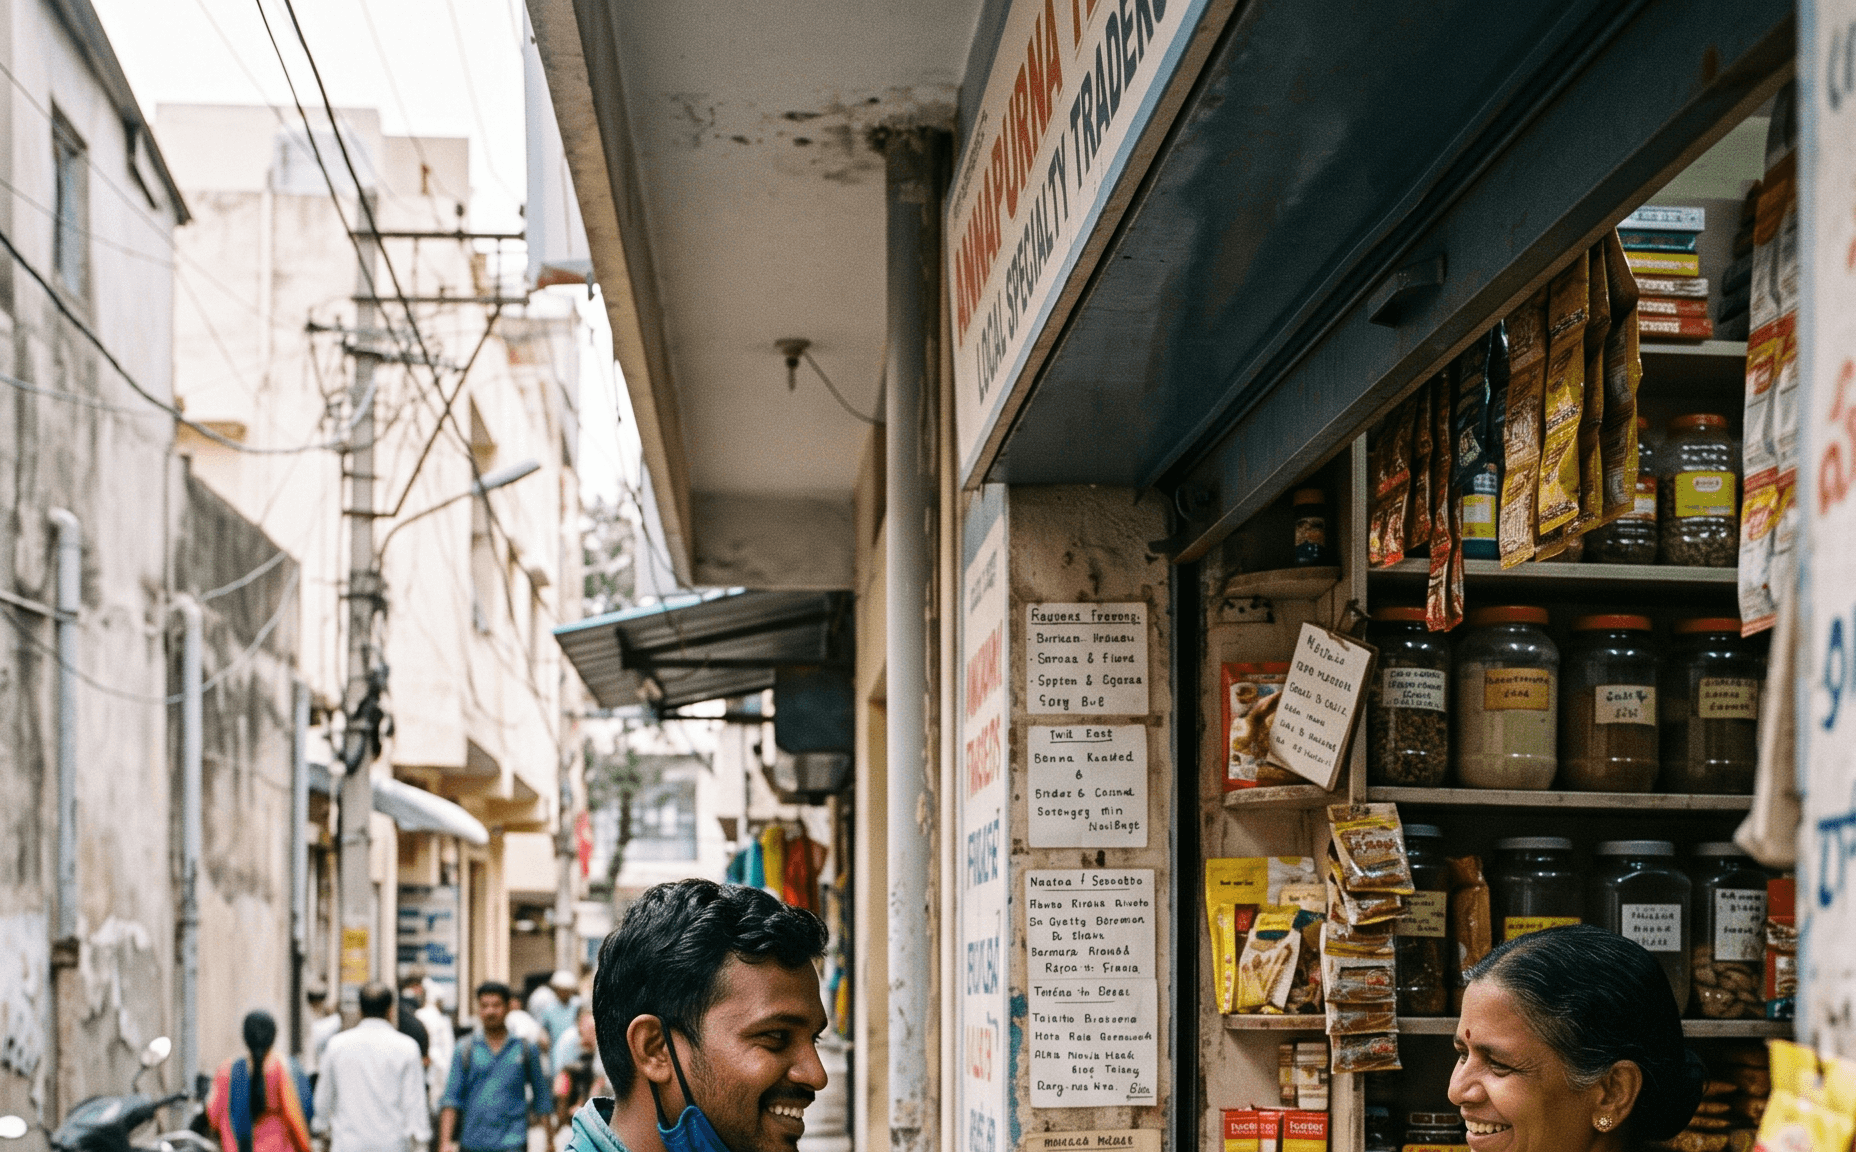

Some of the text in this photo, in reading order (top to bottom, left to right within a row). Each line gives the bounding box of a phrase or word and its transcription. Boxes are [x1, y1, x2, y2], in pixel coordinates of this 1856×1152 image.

[956, 0, 1063, 348] ANNAPURNA
[976, 288, 1007, 406] LOCAL
[1006, 131, 1069, 341] SPECIALTY
